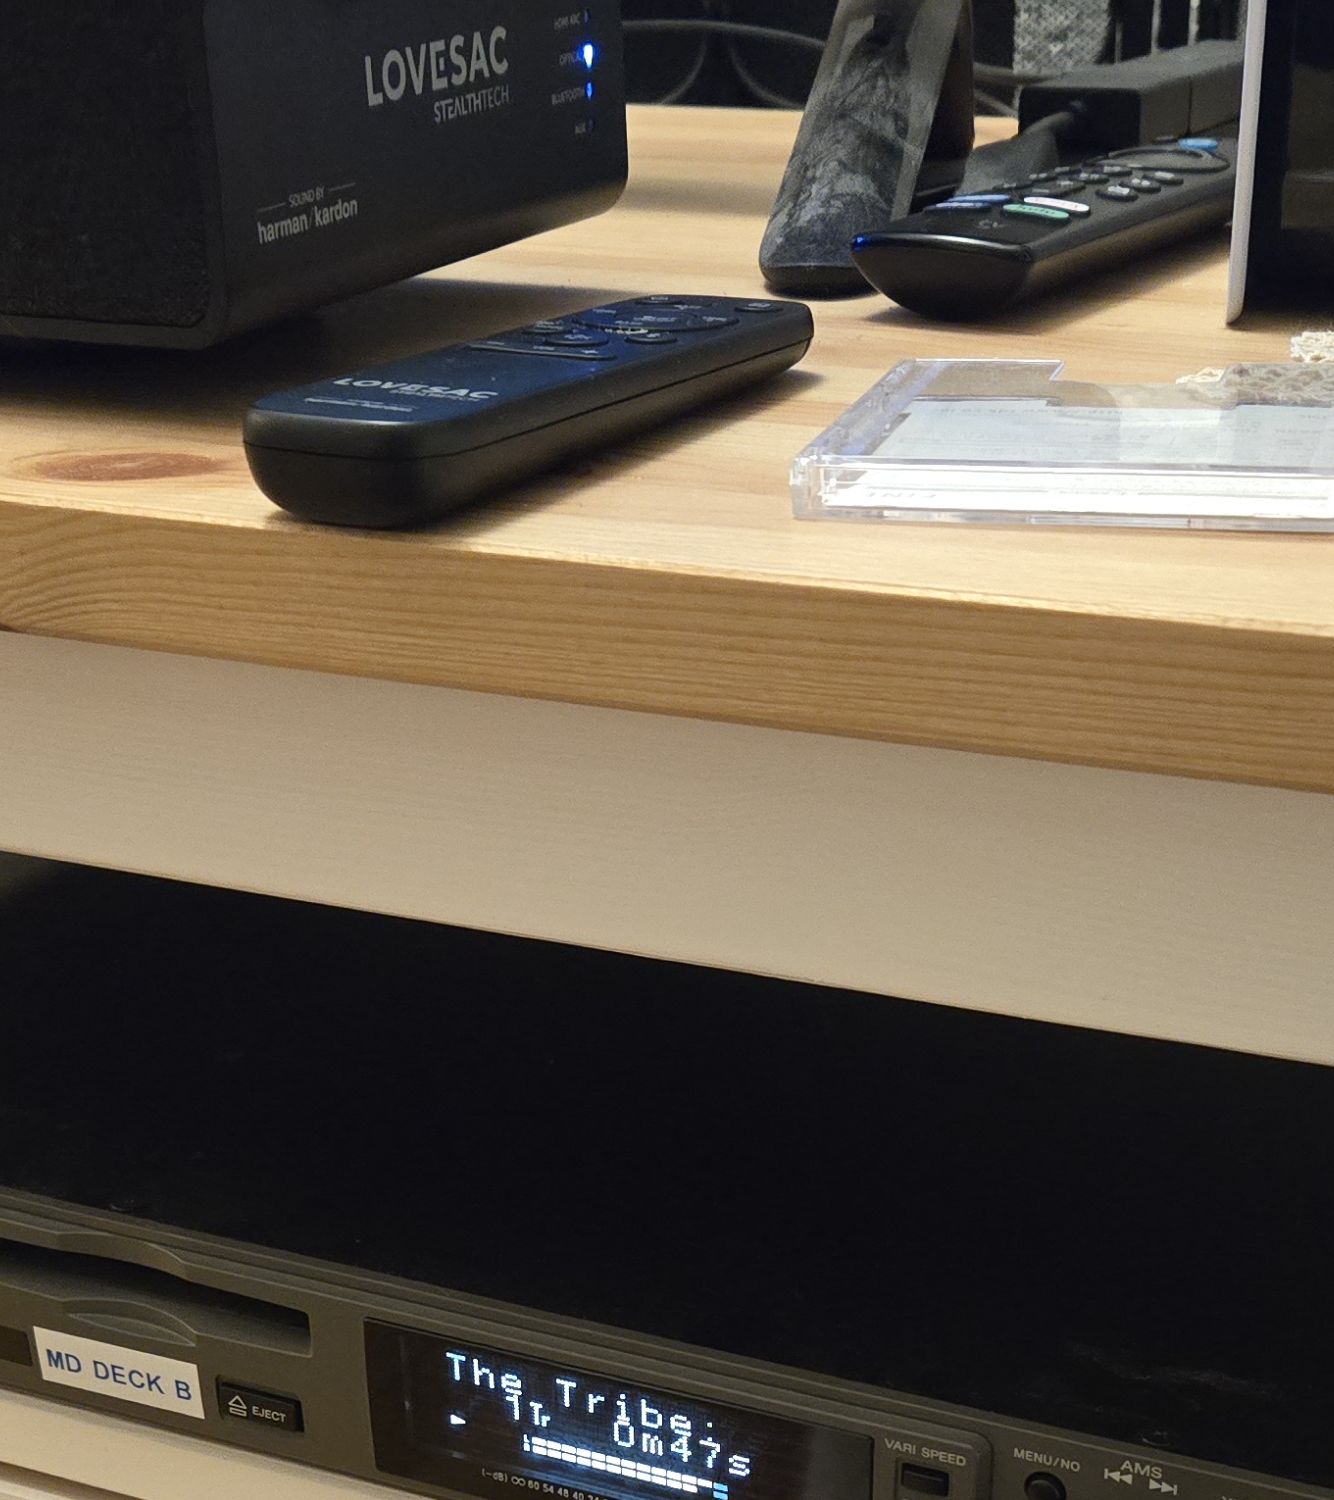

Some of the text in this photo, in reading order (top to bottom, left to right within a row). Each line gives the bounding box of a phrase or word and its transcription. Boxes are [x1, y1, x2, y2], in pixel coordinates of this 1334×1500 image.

[364, 25, 510, 107] LOVESAC
[433, 83, 510, 124] STEALTHTECH
[333, 377, 499, 399] LOVESAC
[45, 1348, 193, 1402] MD DECK B
[445, 1352, 522, 1396] The
[251, 1405, 287, 1424] EJECT
[884, 1437, 967, 1468] VARI SPEED
[1013, 1447, 1081, 1473] MENU/NO
[1120, 1459, 1164, 1480] AMS
[527, 1480, 540, 1492] 60
[542, 1483, 555, 1495] 54
[557, 1486, 570, 1498] 48
